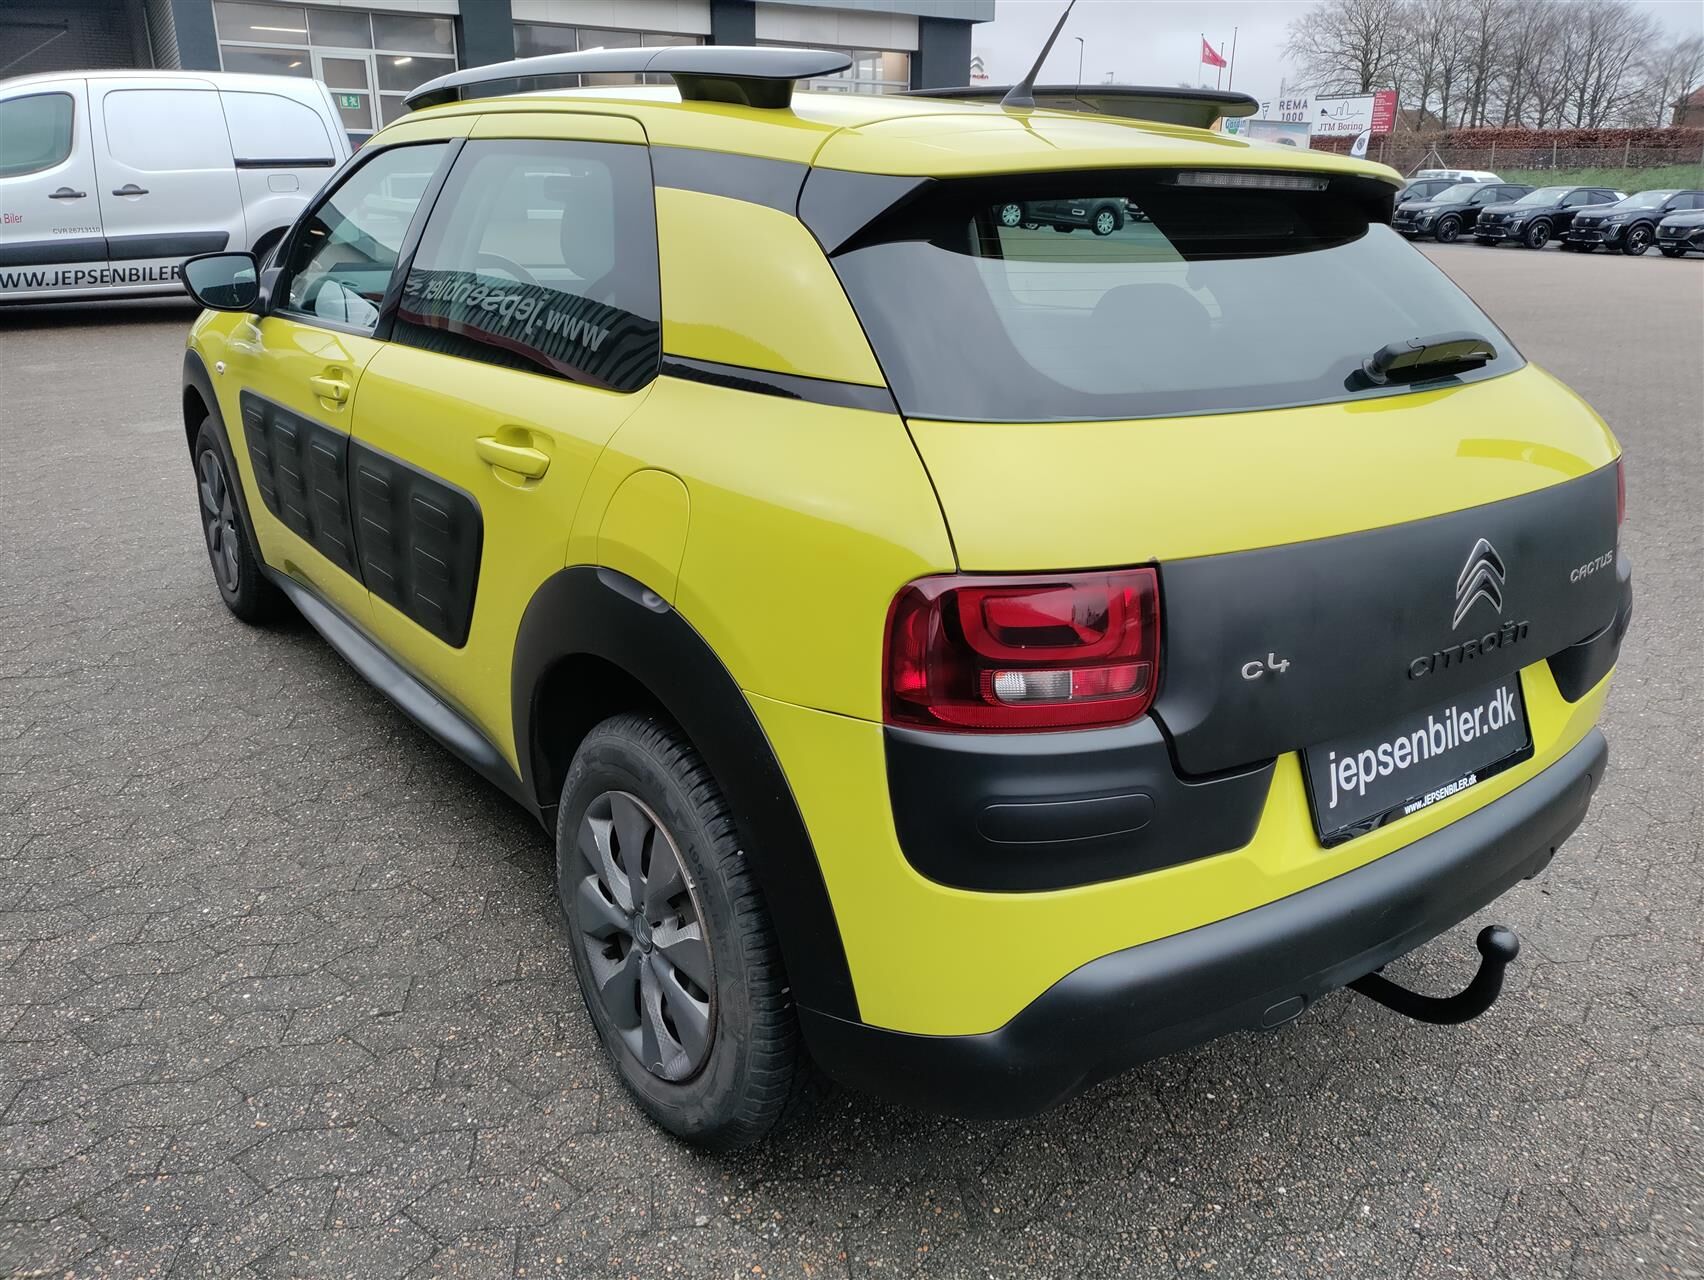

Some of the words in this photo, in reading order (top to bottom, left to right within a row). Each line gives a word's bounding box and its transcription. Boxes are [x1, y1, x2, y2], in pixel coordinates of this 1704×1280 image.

[1279, 99, 1308, 111] REMA
[1281, 111, 1304, 122] 1000
[1318, 123, 1336, 132] JTM
[1337, 121, 1364, 132] Boring
[4, 213, 23, 224] Biler
[1569, 549, 1614, 583] CACTUS
[1328, 685, 1517, 809] jepsenbiler.dk
[1403, 773, 1478, 815] www.JEPSENBILER.dk
